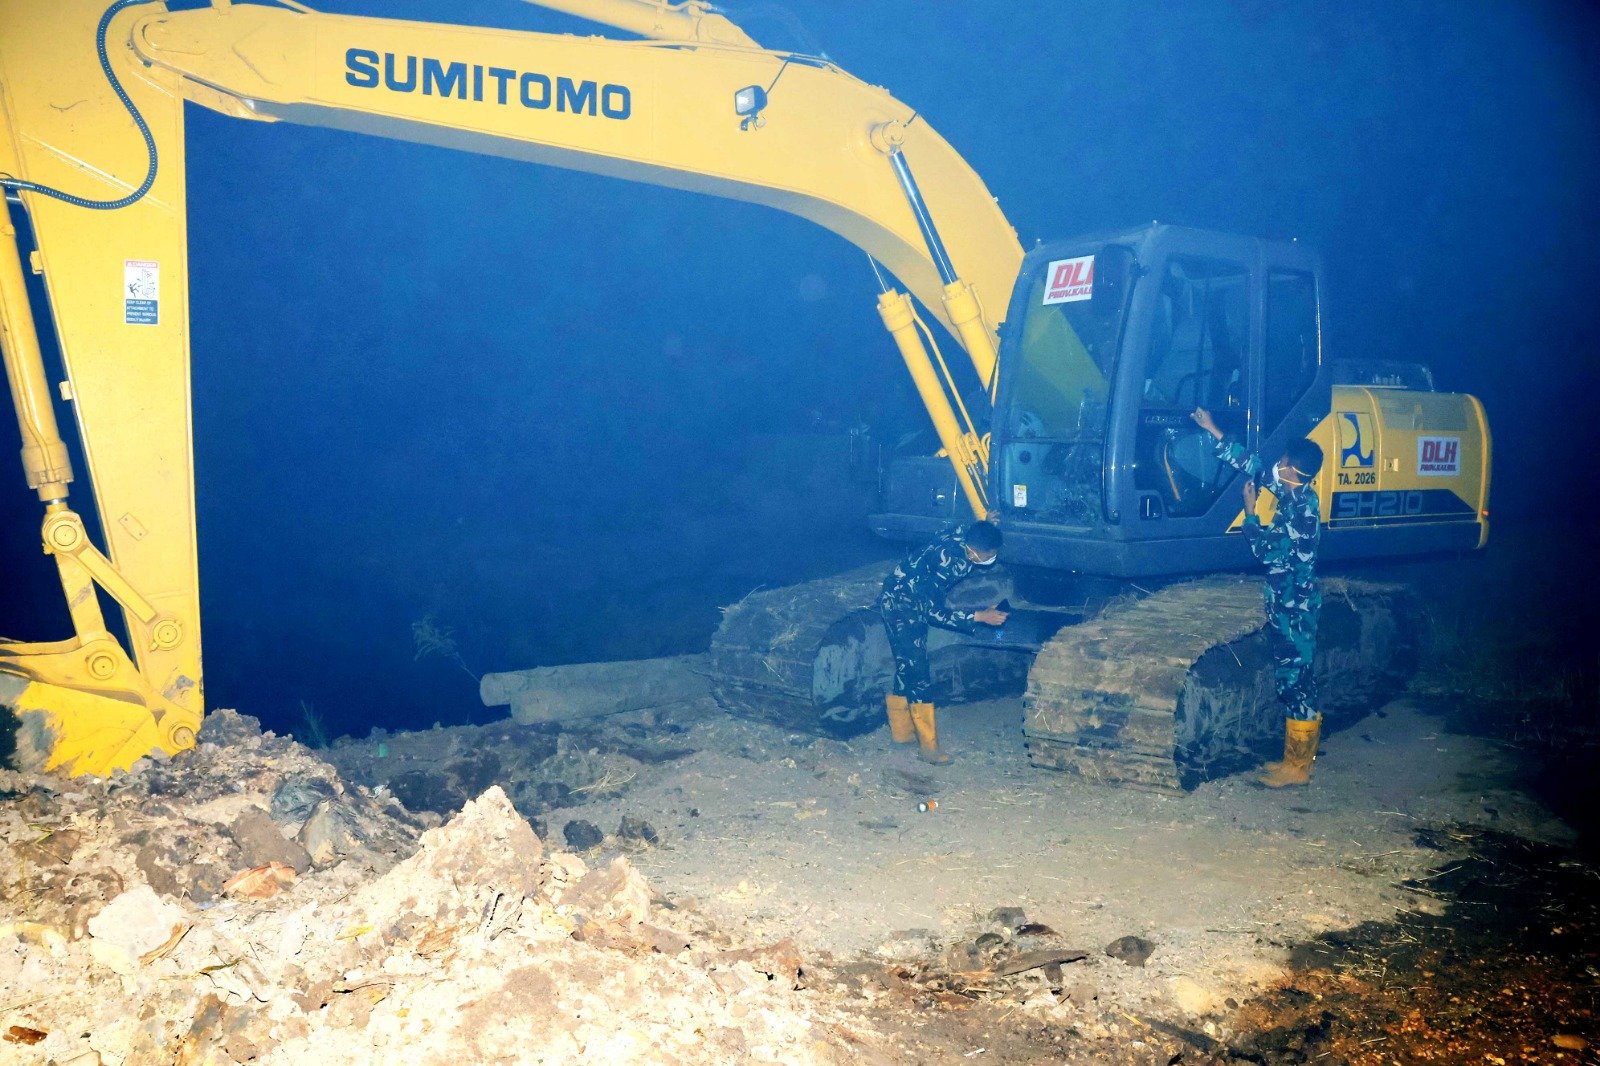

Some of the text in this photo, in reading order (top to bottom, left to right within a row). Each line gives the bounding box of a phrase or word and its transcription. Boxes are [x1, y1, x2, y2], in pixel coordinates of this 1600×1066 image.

[345, 48, 631, 120] SUMITOMO
[1421, 441, 1458, 463] DLH
[1338, 472, 1376, 485] TA. 2026
[1338, 491, 1423, 517] SH210
